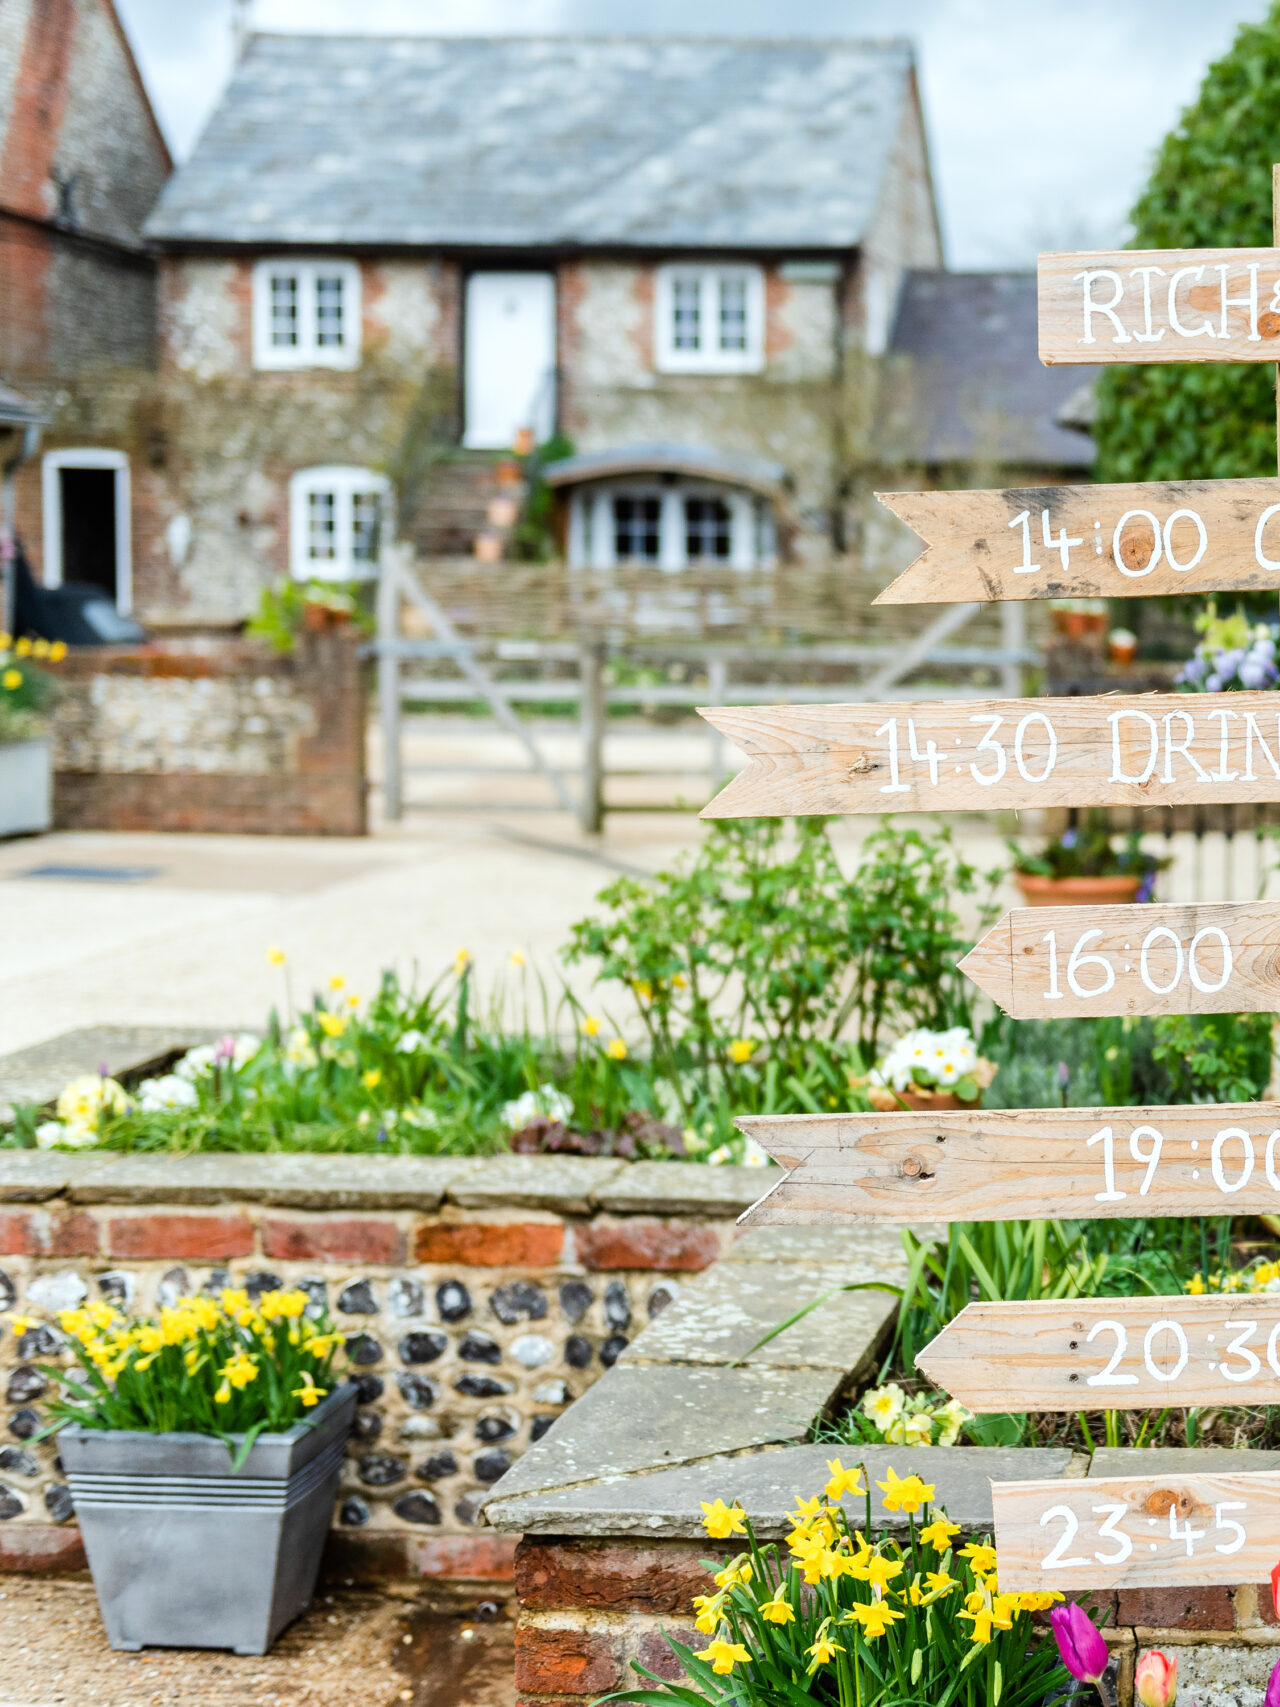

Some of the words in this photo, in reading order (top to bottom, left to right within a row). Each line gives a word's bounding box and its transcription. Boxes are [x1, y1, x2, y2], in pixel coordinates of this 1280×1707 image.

[1073, 262, 1262, 345] RICH
[1007, 508, 1208, 578] 14:00
[875, 711, 1058, 795] 14:30
[1042, 926, 1234, 999] 16:00
[1039, 1500, 1248, 1571] 23:45
